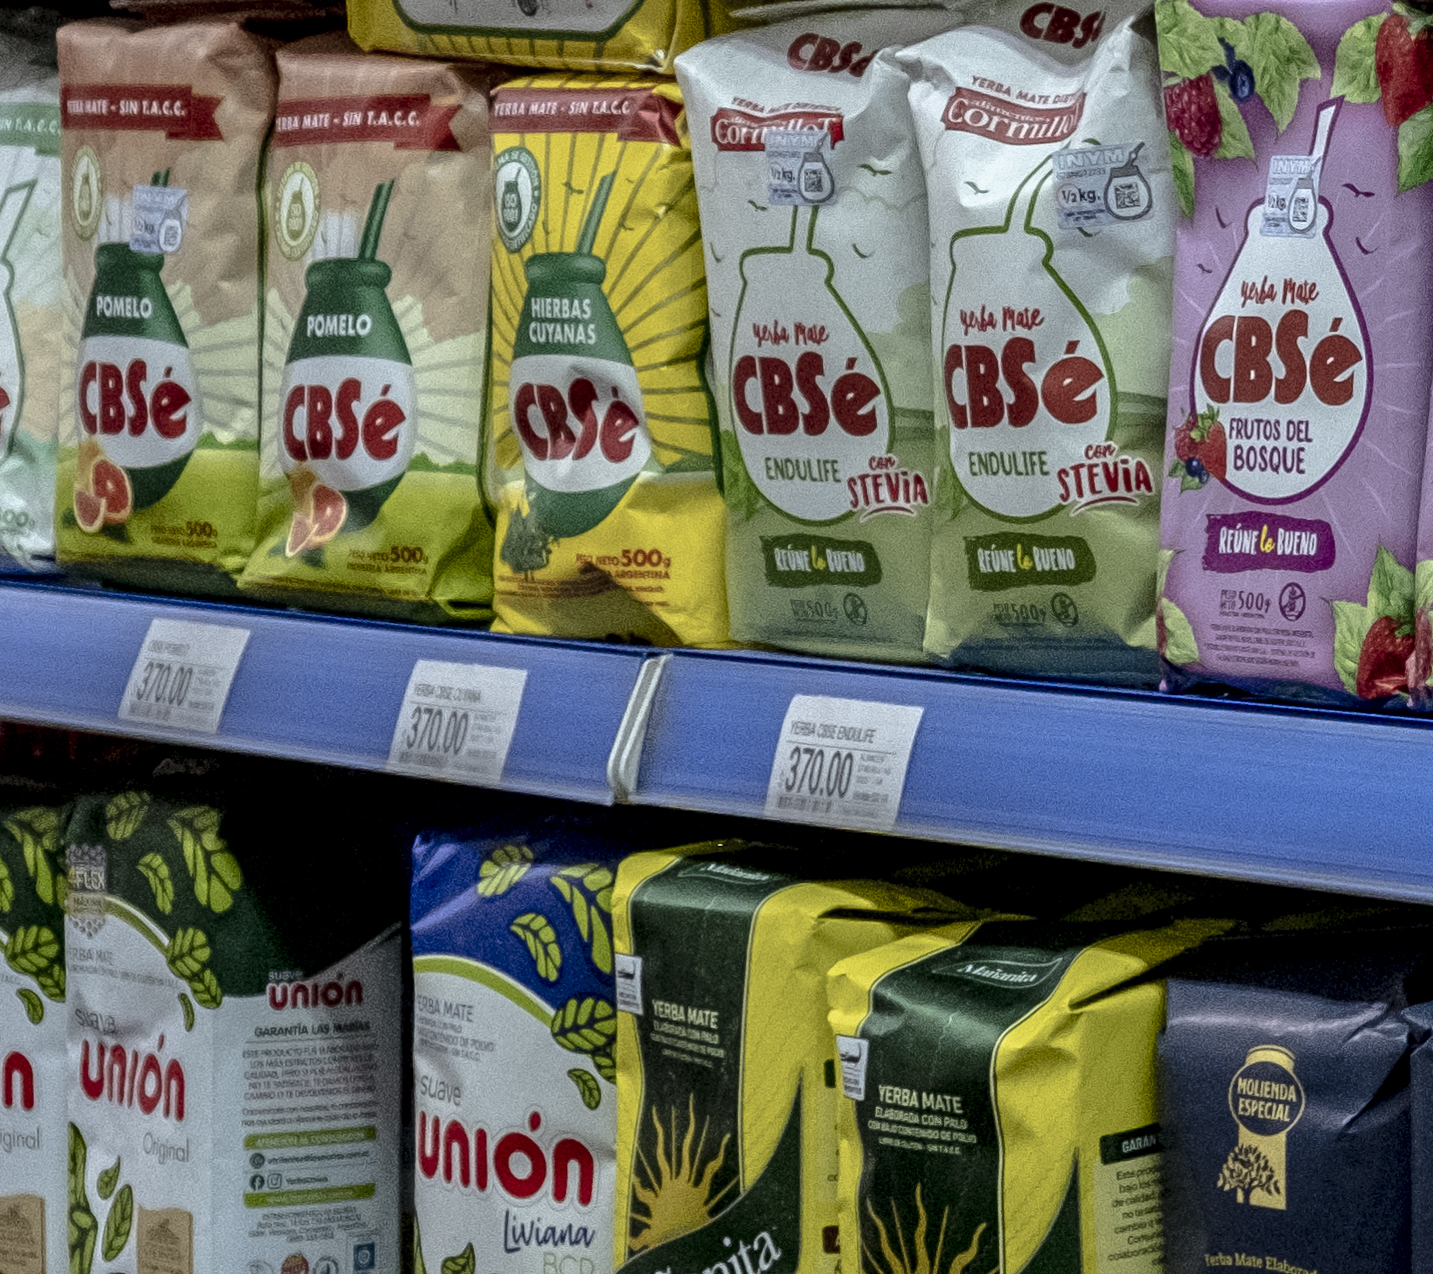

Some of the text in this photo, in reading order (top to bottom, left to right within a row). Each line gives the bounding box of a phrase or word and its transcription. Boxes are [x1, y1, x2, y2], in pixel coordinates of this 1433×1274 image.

[95, 296, 151, 321] POMELO
[531, 296, 591, 319] HIERBAS
[529, 319, 596, 345] CUYANAS
[1201, 310, 1362, 405] CBSé
[945, 338, 1104, 428] CBSé
[79, 358, 192, 439] CBSé
[514, 380, 643, 463] CBSé
[1229, 417, 1313, 444] FRUTOS DEL
[969, 451, 1050, 478] ENDULIFE
[1233, 445, 1306, 473] BOSQUE
[1218, 528, 1259, 555] REÚNE
[1277, 530, 1317, 558] BUENO
[1237, 1076, 1297, 1103] MOLIENDA
[1237, 1098, 1291, 1122] ESPECIAL
[417, 1113, 596, 1208] unión
[504, 1208, 596, 1252] Liviana
